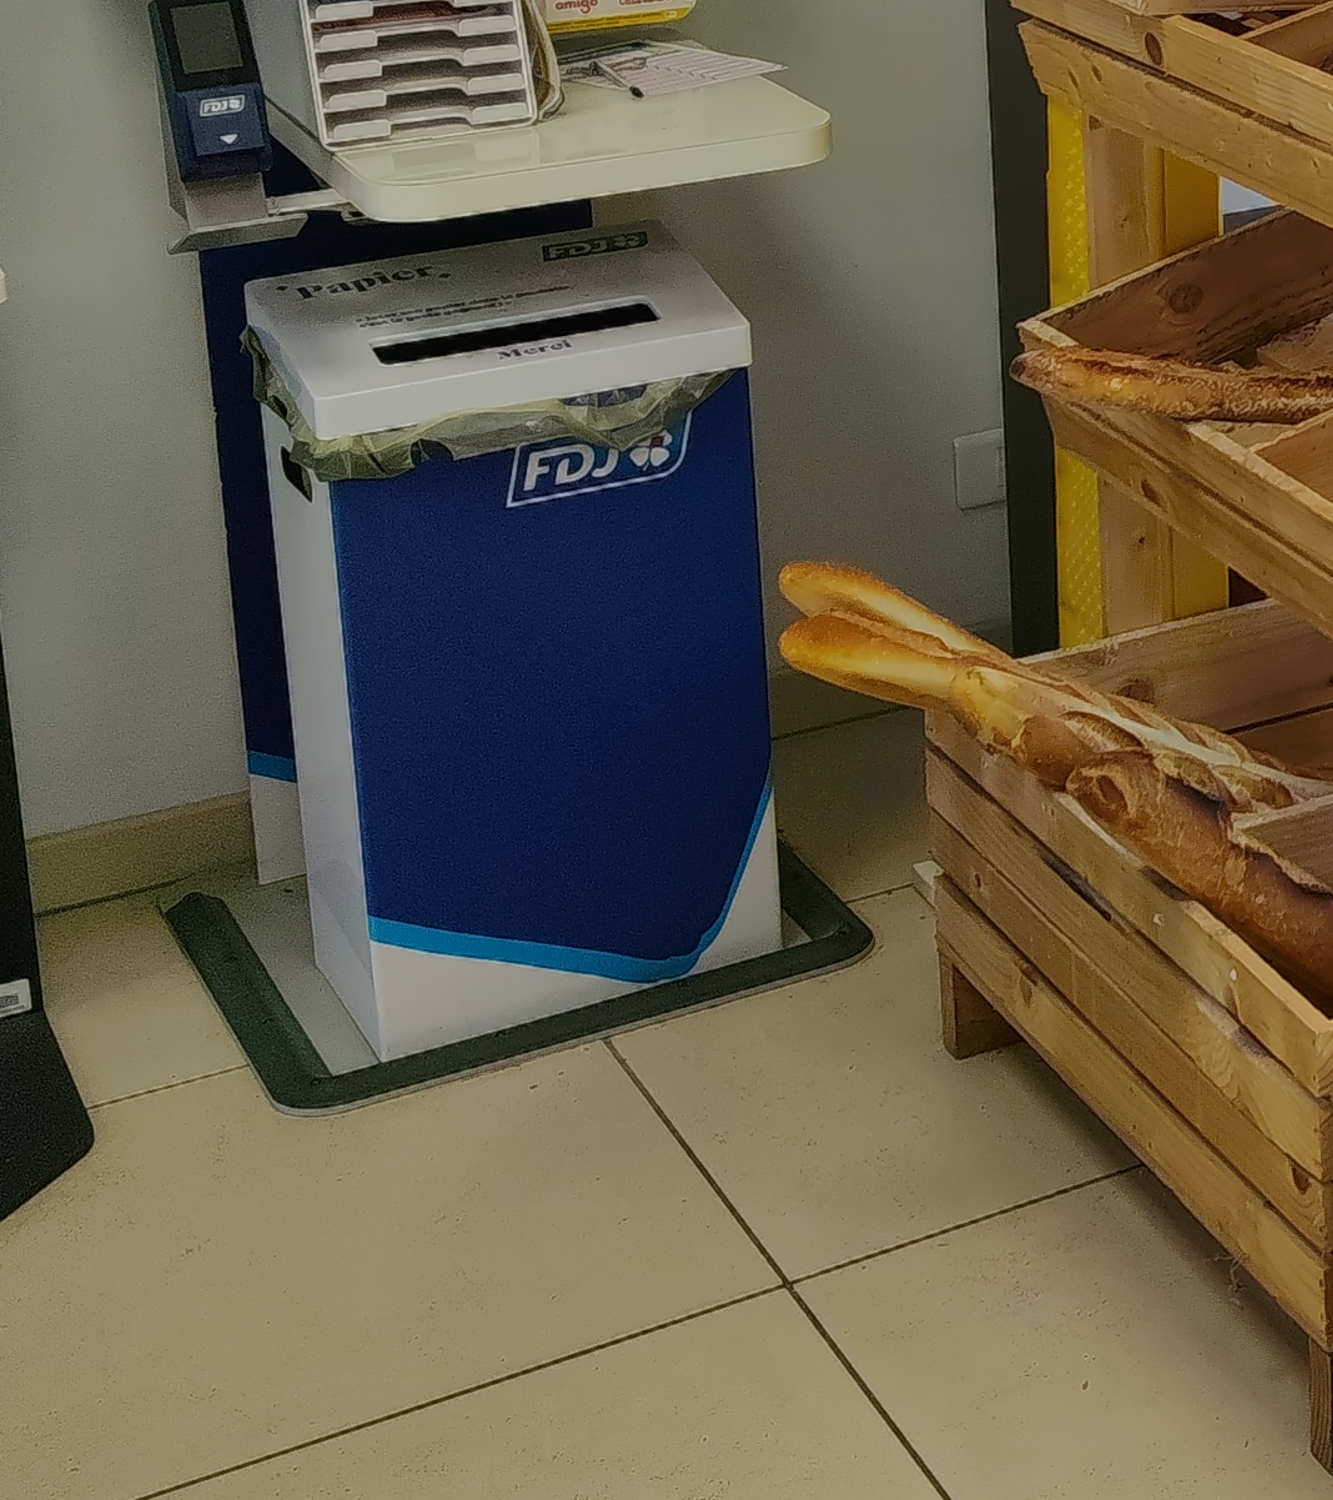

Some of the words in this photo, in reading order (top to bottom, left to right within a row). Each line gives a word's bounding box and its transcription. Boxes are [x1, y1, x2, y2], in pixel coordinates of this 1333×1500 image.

[203, 99, 230, 113] FDJ
[296, 264, 434, 300] Papier
[498, 338, 573, 360] Merci
[523, 443, 619, 491] FDJ
